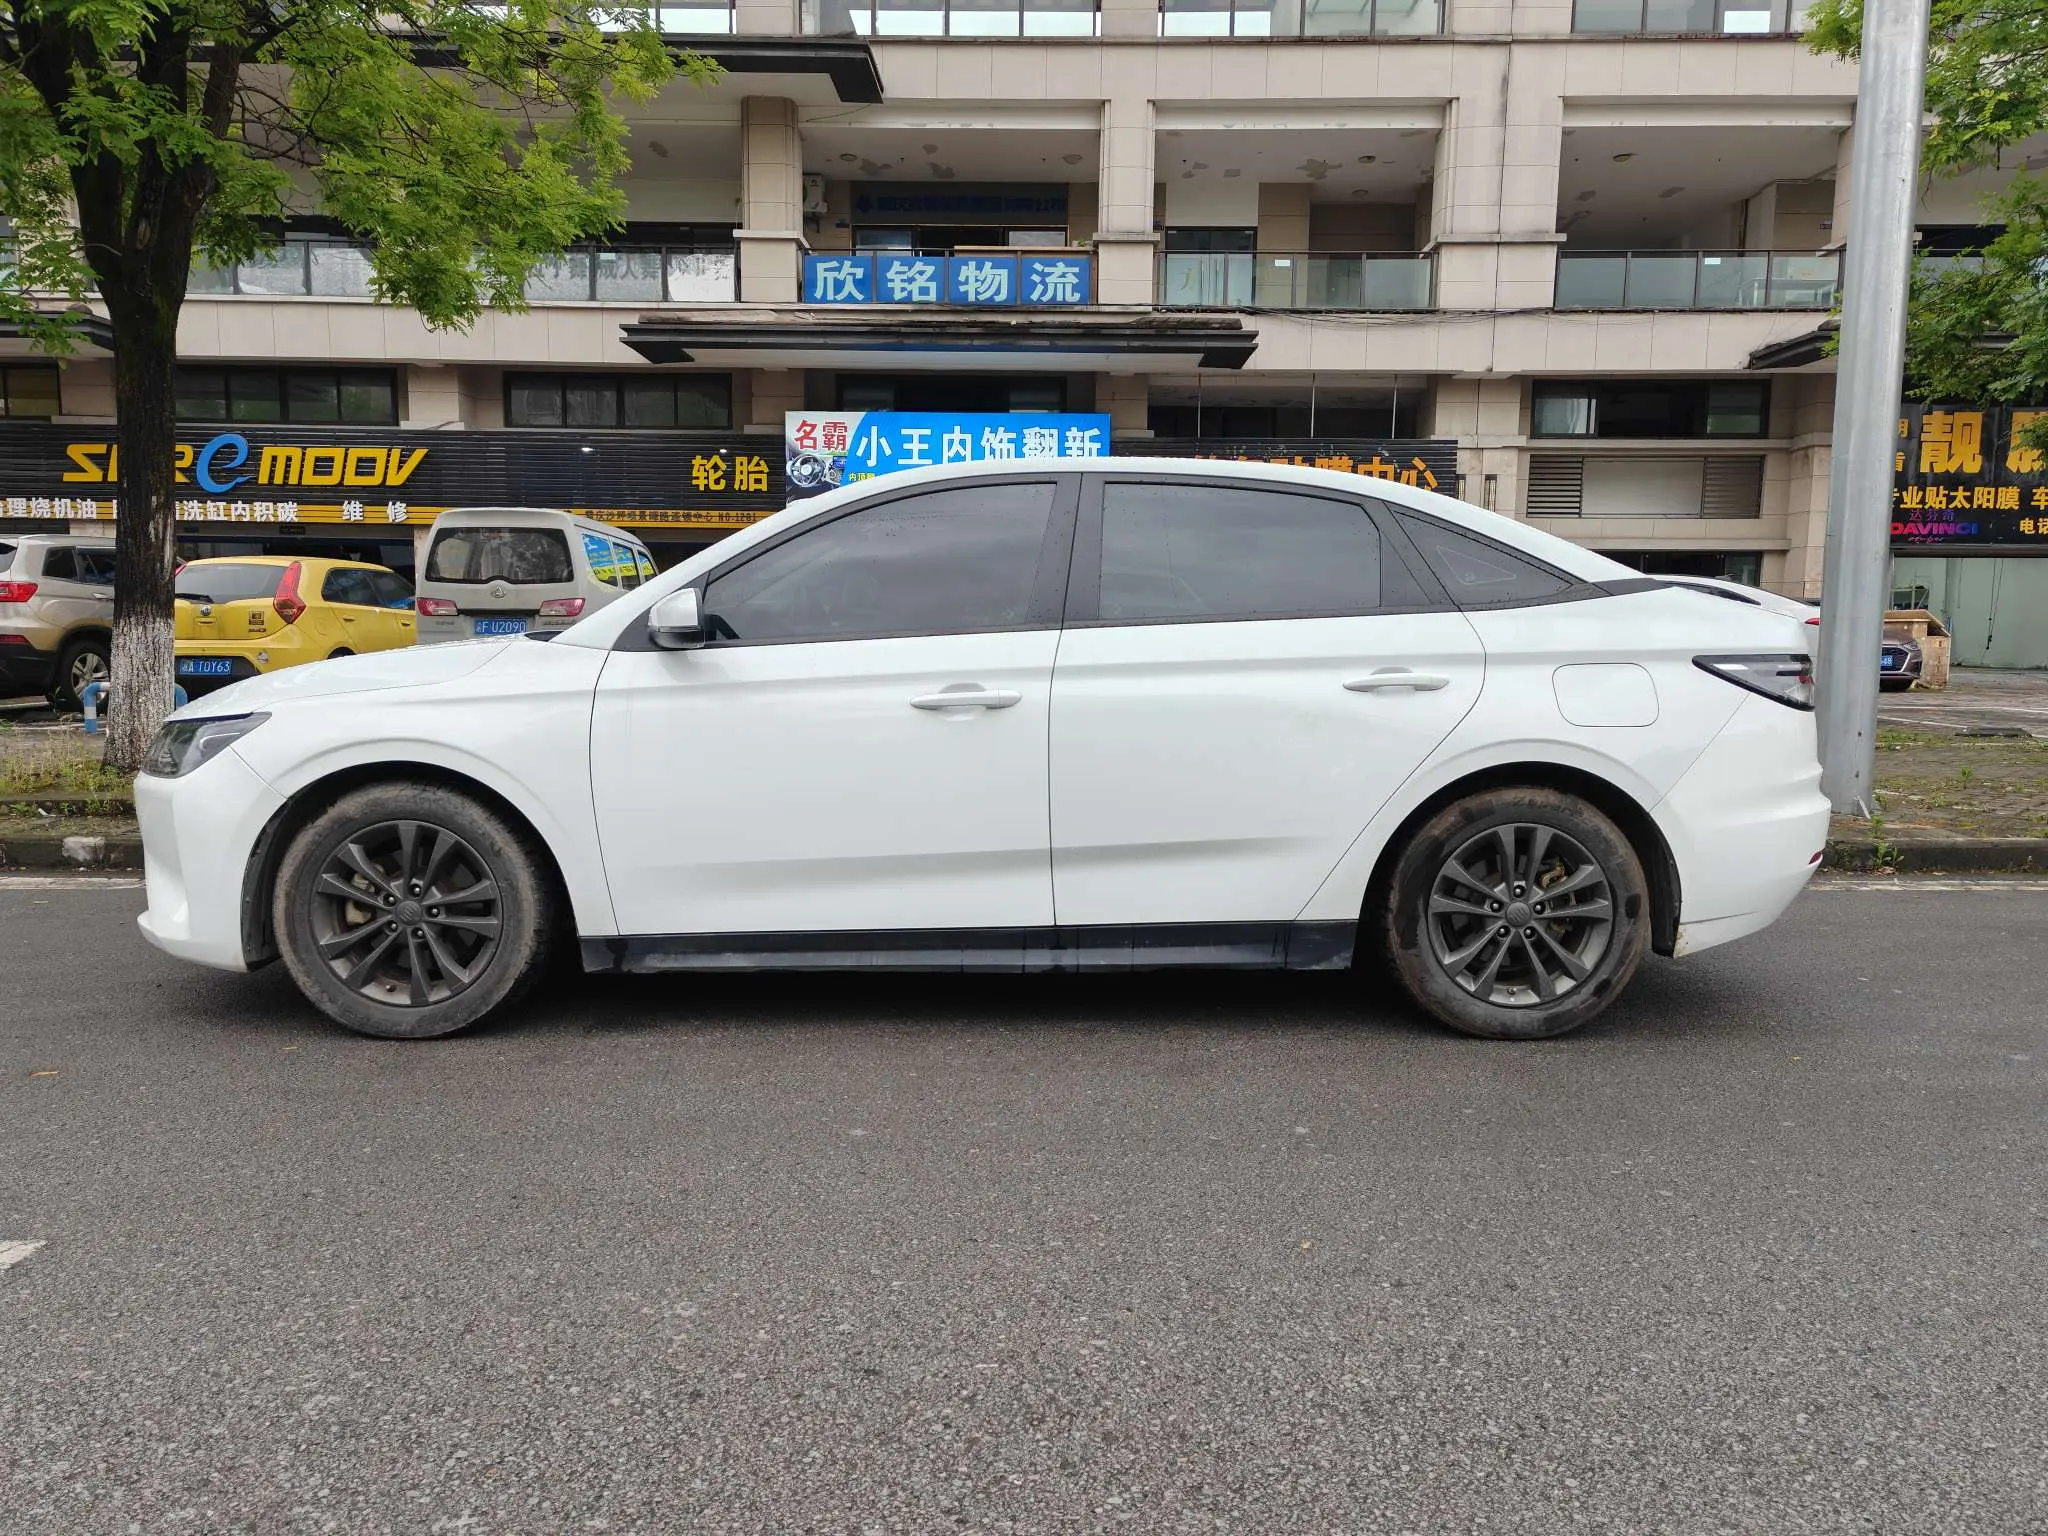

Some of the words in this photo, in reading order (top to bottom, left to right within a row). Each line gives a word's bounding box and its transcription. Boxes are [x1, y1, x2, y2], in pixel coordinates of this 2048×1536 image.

[814, 260, 1081, 303] 欣铭物流
[794, 420, 848, 451] 名霸
[856, 425, 1102, 466] 小王内饰翻新
[692, 455, 769, 492] 轮胎
[0, 497, 97, 519] 理烧机油
[176, 500, 298, 522] 洗缸内积碳
[1909, 509, 1955, 521] 达芬奇
